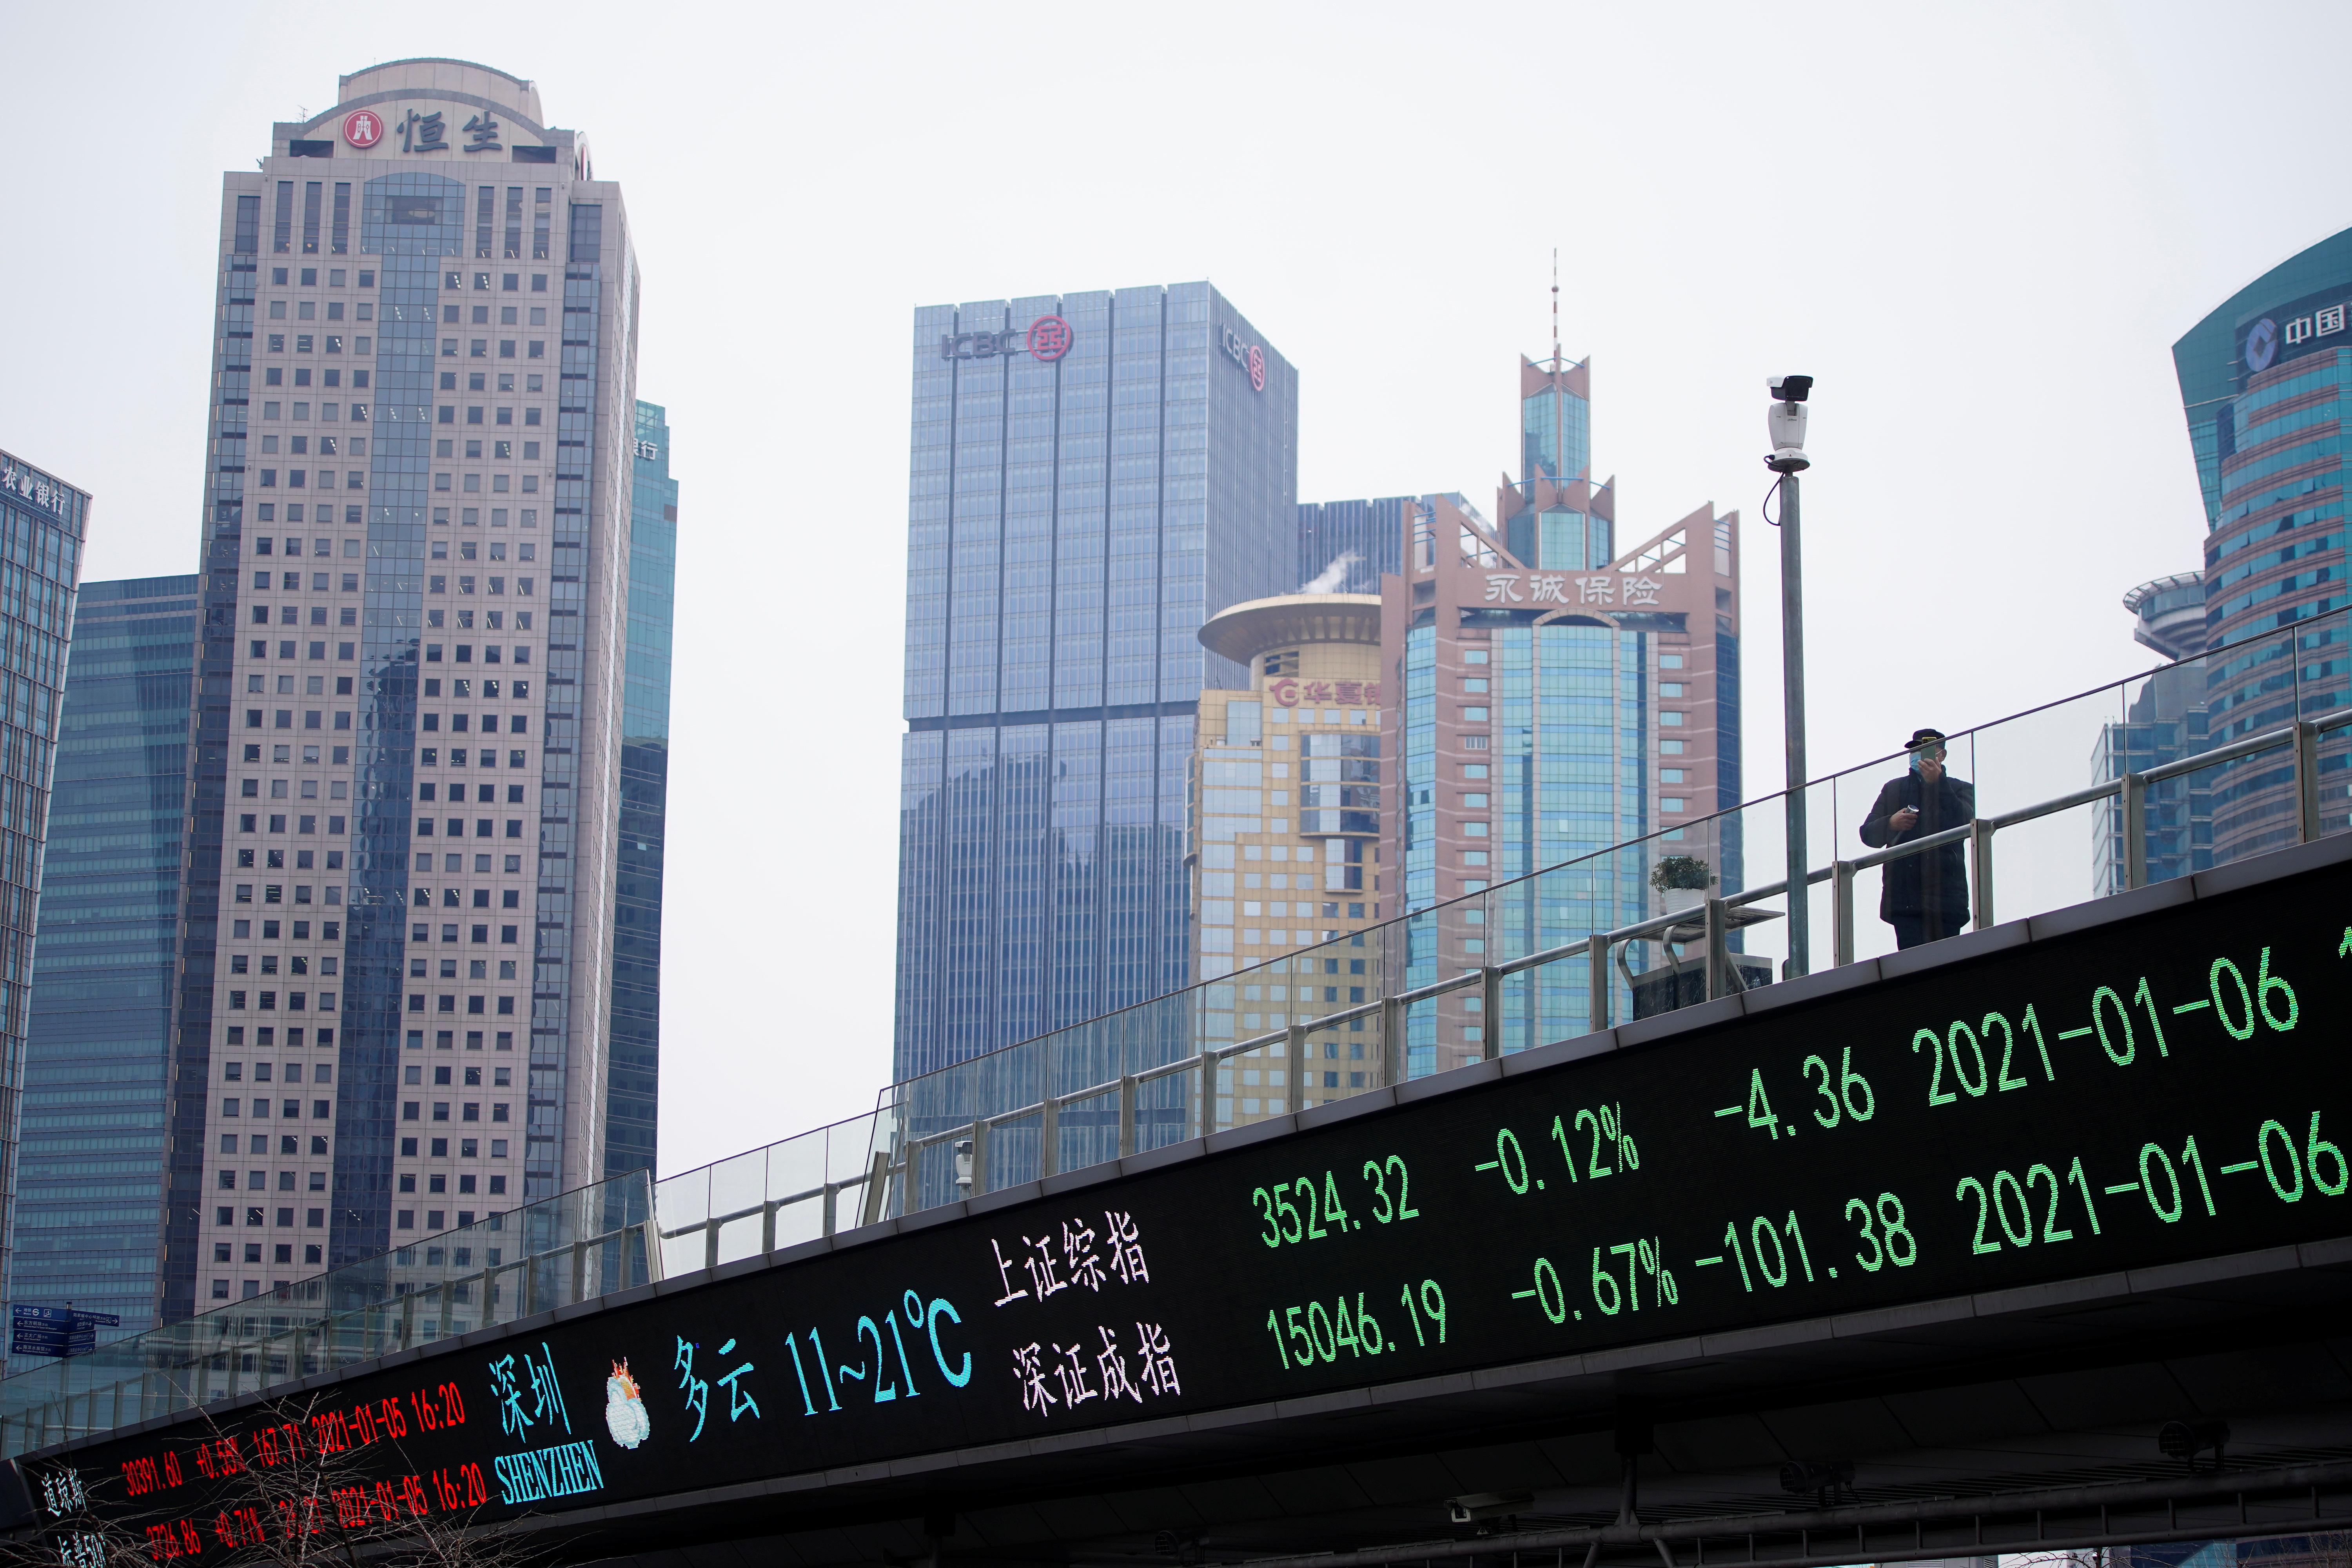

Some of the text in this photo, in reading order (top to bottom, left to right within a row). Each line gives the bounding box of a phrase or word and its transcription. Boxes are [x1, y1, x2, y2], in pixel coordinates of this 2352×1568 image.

[397, 109, 503, 152] 恒生
[942, 328, 1016, 359] ICBC
[2285, 304, 2352, 344] 中国
[1, 466, 65, 515] 农业银行
[1485, 574, 1663, 606] 永诚保险
[992, 947, 2298, 1307] 上证综指 3524.32 -0.12% -4.36 2021-01-06
[1013, 1111, 2349, 1416] 深证成指 15046.19 -0.67% -101.38 2021-01-06
[489, 1342, 571, 1443] 深圳
[674, 1335, 760, 1442] 多云
[42, 1468, 87, 1516] 道琼斯
[122, 1450, 182, 1496] 30391.60
[254, 1423, 305, 1467] 167.71
[312, 1397, 407, 1454] 2021-01-05
[411, 1382, 465, 1432] 16:20
[495, 1440, 604, 1504] SHENZHEN
[146, 1518, 201, 1561] 3726.86
[279, 1496, 325, 1538] 2621
[332, 1475, 428, 1528] 2021-01-05
[433, 1462, 487, 1511] 16:20
